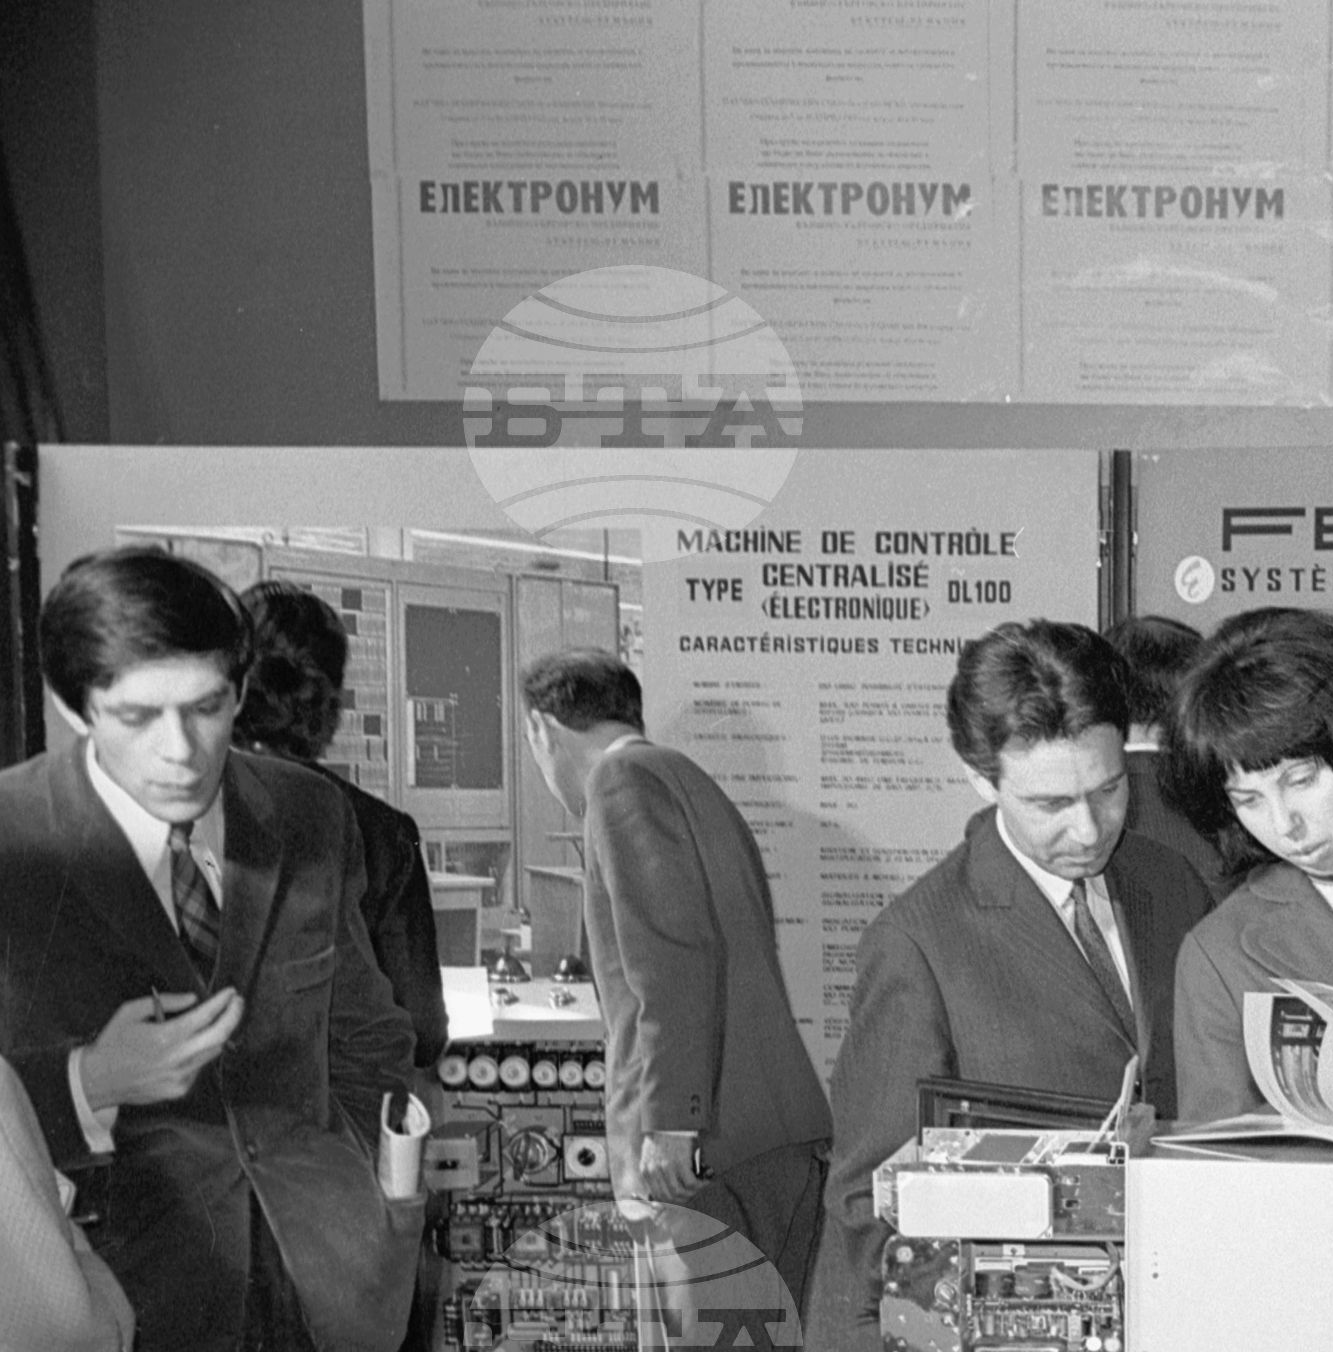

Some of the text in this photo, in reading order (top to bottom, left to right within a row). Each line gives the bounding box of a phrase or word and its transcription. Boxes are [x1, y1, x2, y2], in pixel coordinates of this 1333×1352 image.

[418, 180, 660, 214] ЕЛЕКТРОНУМ
[727, 180, 971, 216] ЕЛЕКТРОНУМ
[1040, 184, 1285, 220] ЕЛЕКТРОНУМ
[677, 526, 801, 555] MACHINE
[820, 530, 856, 556] DE
[685, 577, 743, 602] TYPE
[761, 560, 930, 589] CENTRALISÉ
[678, 632, 962, 655] CARACTÉRISTIQUES TECHNI
